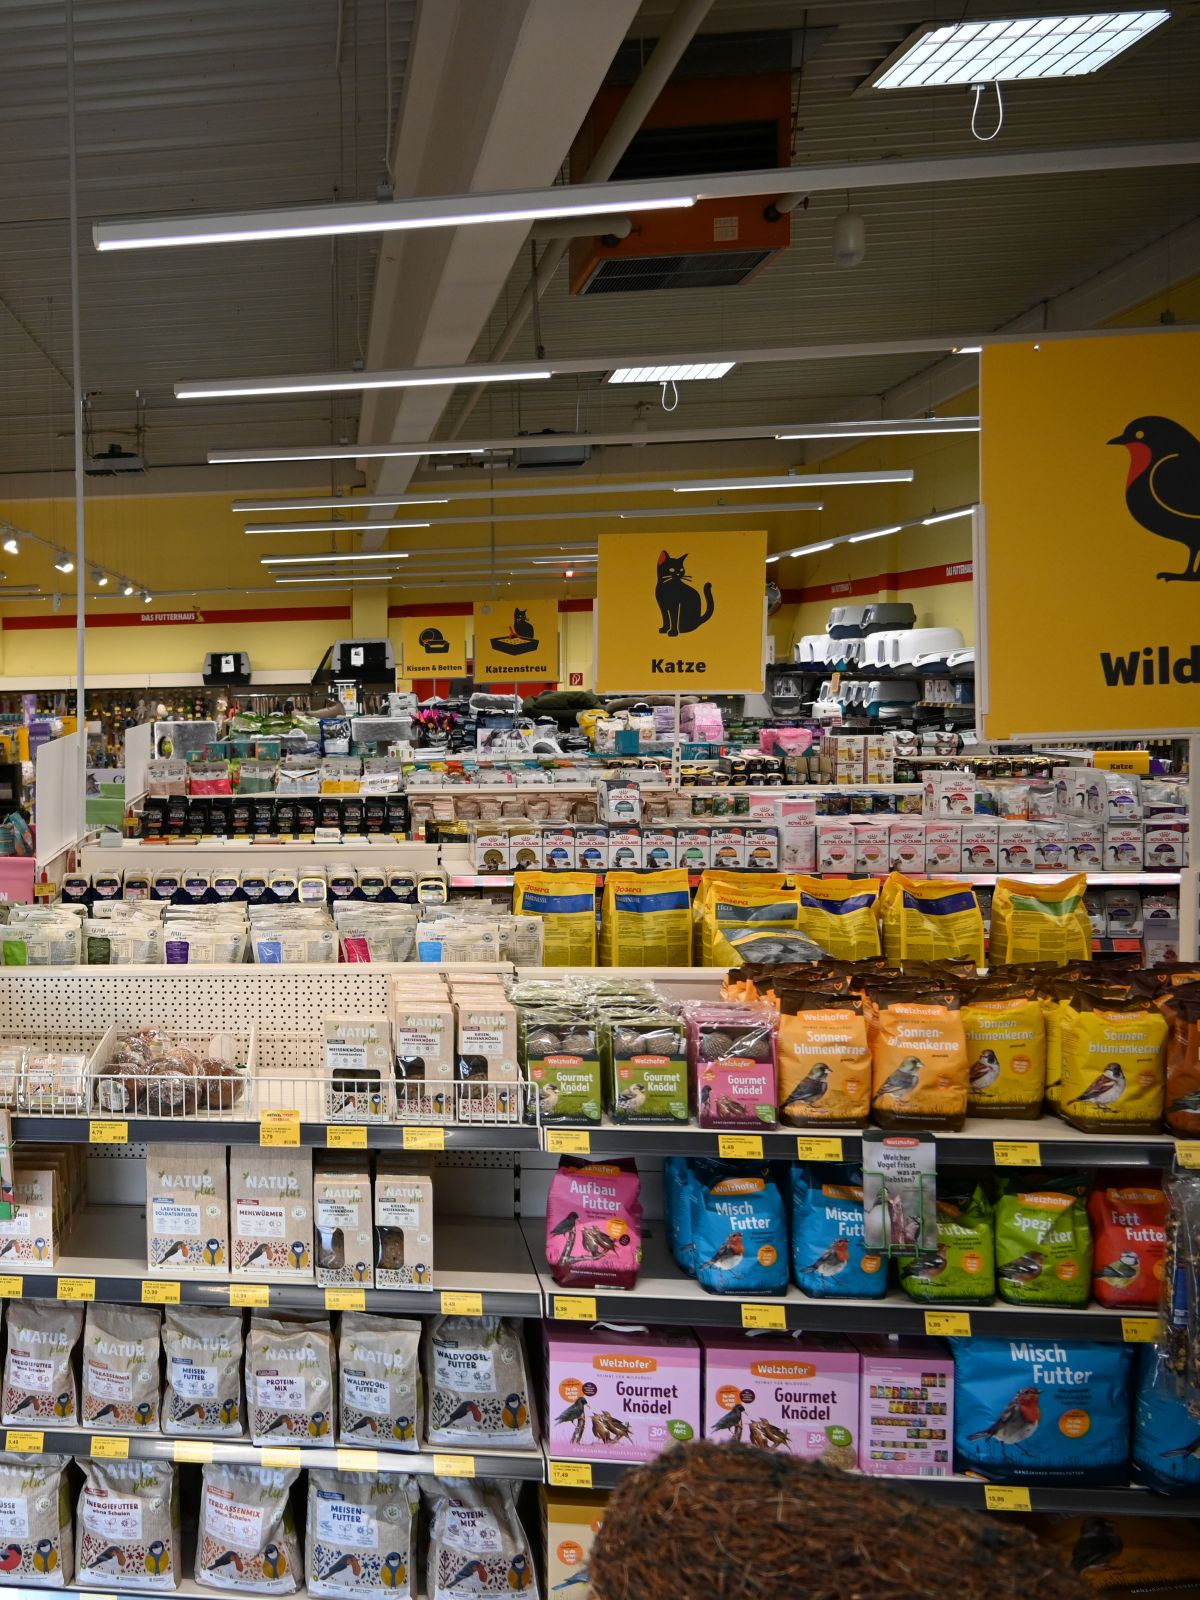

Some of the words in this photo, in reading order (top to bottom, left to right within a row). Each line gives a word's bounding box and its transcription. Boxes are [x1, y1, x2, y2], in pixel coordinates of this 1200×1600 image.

[155, 612, 195, 621] FUTTERHAUS
[407, 664, 430, 672] Kissen
[485, 665, 547, 674] Katzenstreu
[651, 658, 707, 674] Katze
[525, 885, 550, 893] Josera
[718, 896, 749, 906] Josera
[895, 1006, 941, 1015] Welzhofer
[407, 1018, 443, 1027] NATUR
[469, 1015, 507, 1025] NATUR
[803, 1013, 849, 1021] Welzhofer
[978, 1017, 1023, 1029] Sonnen-
[336, 1027, 377, 1038] NATUR
[807, 1031, 853, 1043] Sonnen-
[897, 1025, 943, 1038] Sonnen-
[1104, 1029, 1147, 1041] Sonnen-
[794, 1043, 866, 1055] blumenkerne
[547, 1057, 580, 1065] Welzhofer
[634, 1057, 667, 1065] Welzhofer
[556, 1072, 594, 1082] Gourmet
[643, 1072, 680, 1082] Gourmet
[727, 1075, 767, 1085] Gourmet
[560, 1082, 590, 1092] Knödel
[647, 1081, 678, 1092] Knödel
[732, 1085, 763, 1095] Knödel
[877, 1161, 896, 1169] Vogel
[161, 1174, 213, 1189] NATUR
[246, 1177, 299, 1190] NATUR
[714, 1181, 758, 1193] Welzhofer
[326, 1188, 361, 1198] NATUR
[387, 1187, 422, 1198] NATUR
[570, 1180, 616, 1197] Aufbau
[582, 1196, 622, 1211] Futter
[1024, 1194, 1071, 1206] Welzhofer
[239, 1209, 283, 1218] MEHLWÜRMER
[715, 1202, 753, 1216] Misch
[825, 1207, 863, 1222] Misch
[730, 1216, 771, 1231] Futter
[1013, 1213, 1053, 1231] Spezi
[1112, 1211, 1141, 1226] Fett
[19, 1330, 69, 1345] NATUR
[181, 1335, 230, 1350] NATUR
[98, 1342, 145, 1358] NATUR
[265, 1349, 317, 1361] NATUR
[1009, 1342, 1067, 1362] Misch
[353, 1351, 404, 1368] NATUR
[437, 1350, 491, 1362] WALDVOGEL-
[12, 1358, 52, 1369] ENERGIEFUTTER
[448, 1359, 477, 1369] FUTTER
[599, 1358, 649, 1369] Welzhofer
[90, 1368, 130, 1380] TERRASSENMIX
[757, 1365, 808, 1375] Welzhofer
[1032, 1363, 1093, 1385] Futter
[183, 1373, 205, 1381] FUTTER
[266, 1378, 297, 1386] PROTEIN-
[346, 1377, 388, 1390] WALDVOGEL-
[355, 1385, 378, 1394] FUTTER
[616, 1381, 678, 1398] Gourmet
[774, 1387, 837, 1404] Gourmet
[623, 1398, 671, 1414] Knödel
[781, 1404, 830, 1420] Knödel
[221, 1464, 285, 1488] NATUR
[132, 1473, 158, 1495] plus
[86, 1500, 139, 1510] ENERGIEFUTTER
[208, 1499, 261, 1519] TERRASSENMIX
[330, 1505, 366, 1515] MEISEN-
[228, 1512, 252, 1523] Schalen
[332, 1513, 362, 1524] FUTTER
[451, 1510, 487, 1520] PROTEIN-
[460, 1519, 477, 1528] MIX
